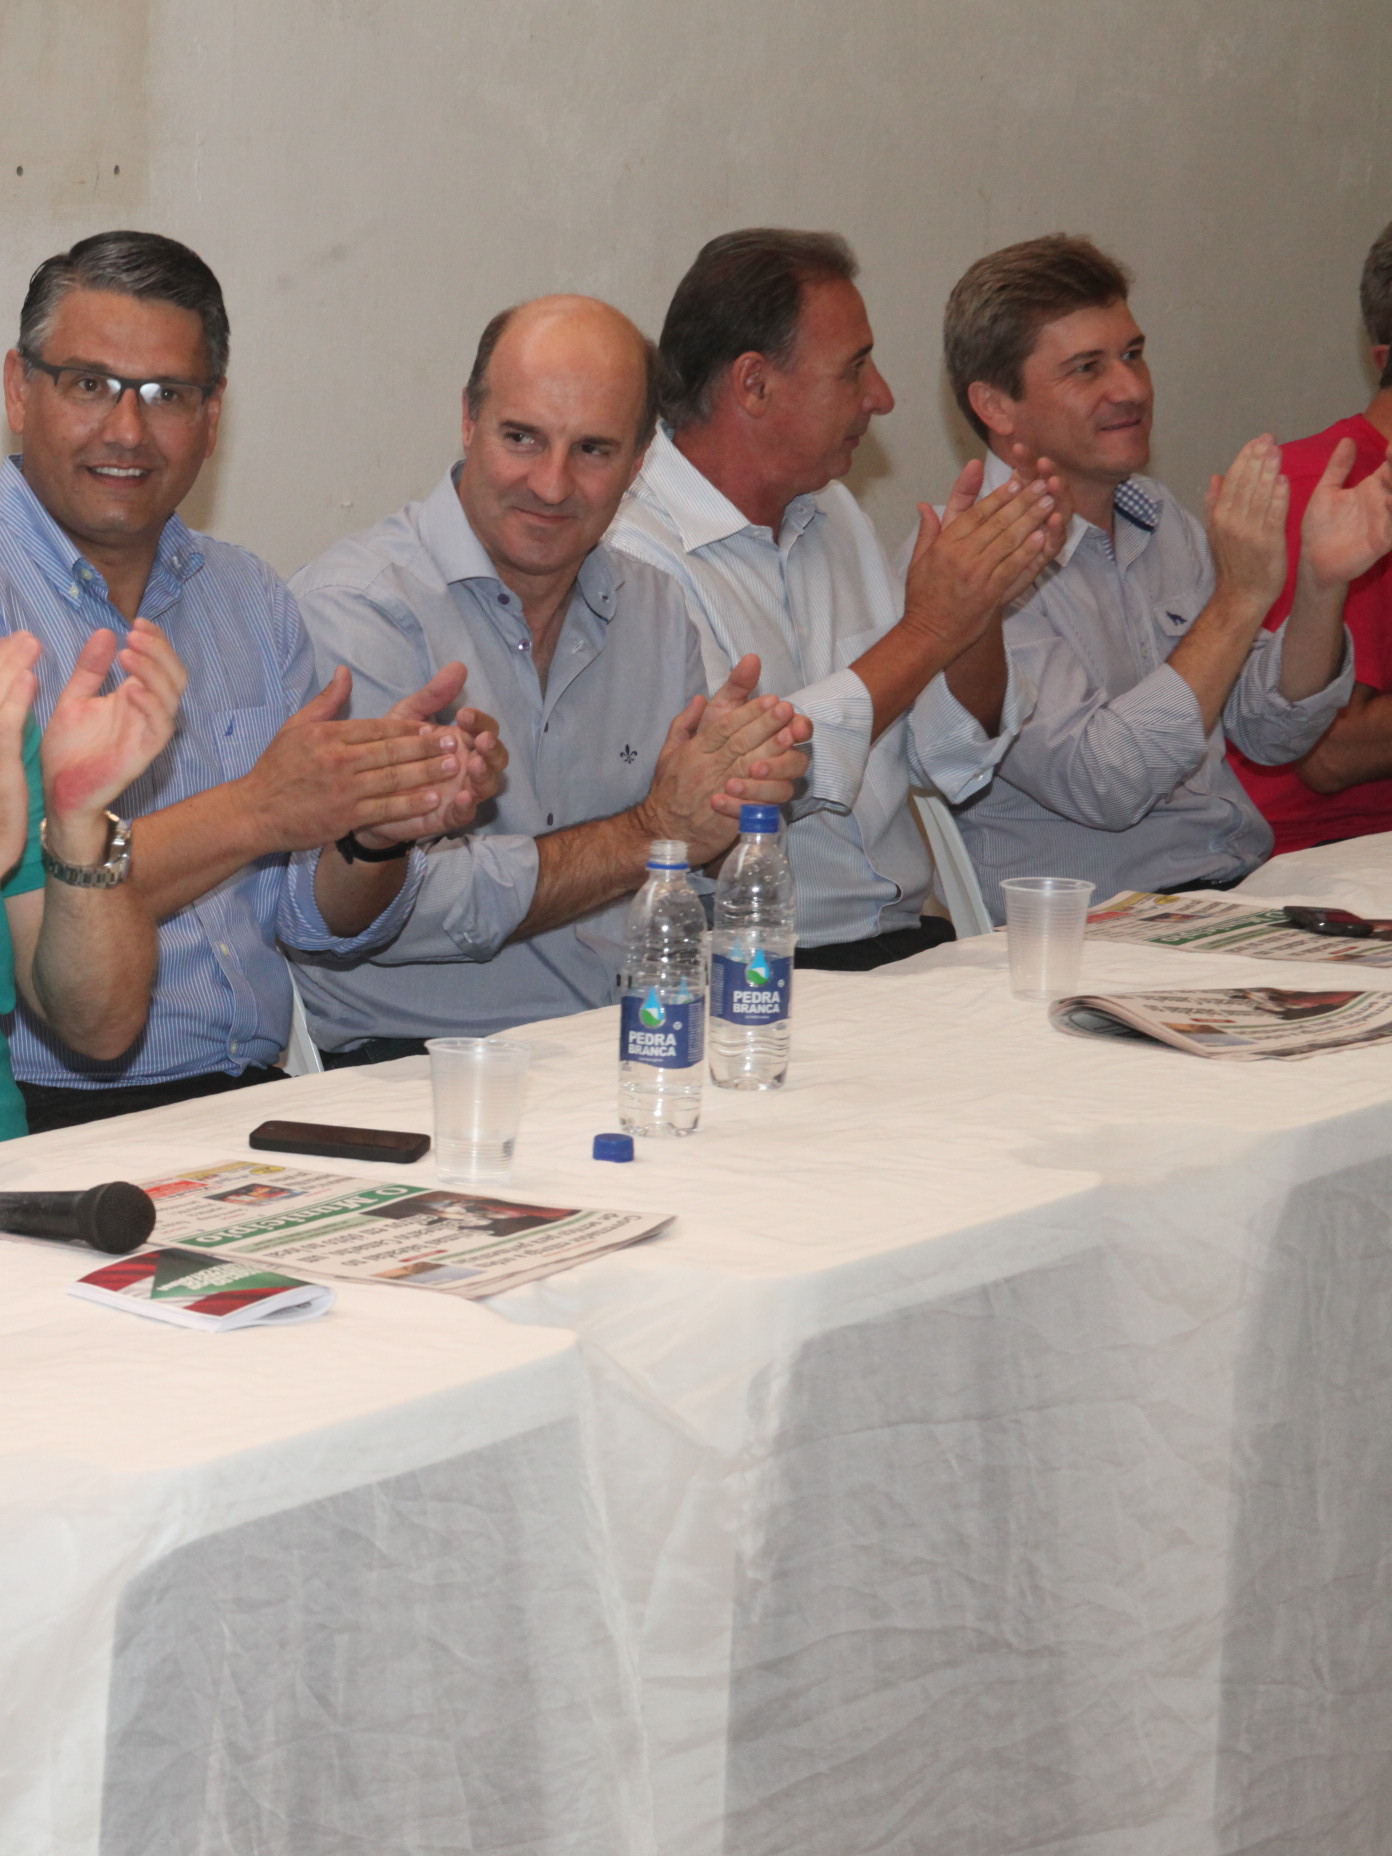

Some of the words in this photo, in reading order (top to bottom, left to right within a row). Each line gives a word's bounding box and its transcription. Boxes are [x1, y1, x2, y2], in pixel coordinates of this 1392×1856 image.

[733, 990, 780, 1003] PEDRA
[733, 1003, 780, 1013] BRANCA
[629, 1031, 677, 1046] PEDRA
[628, 1043, 677, 1057] BRANCA
